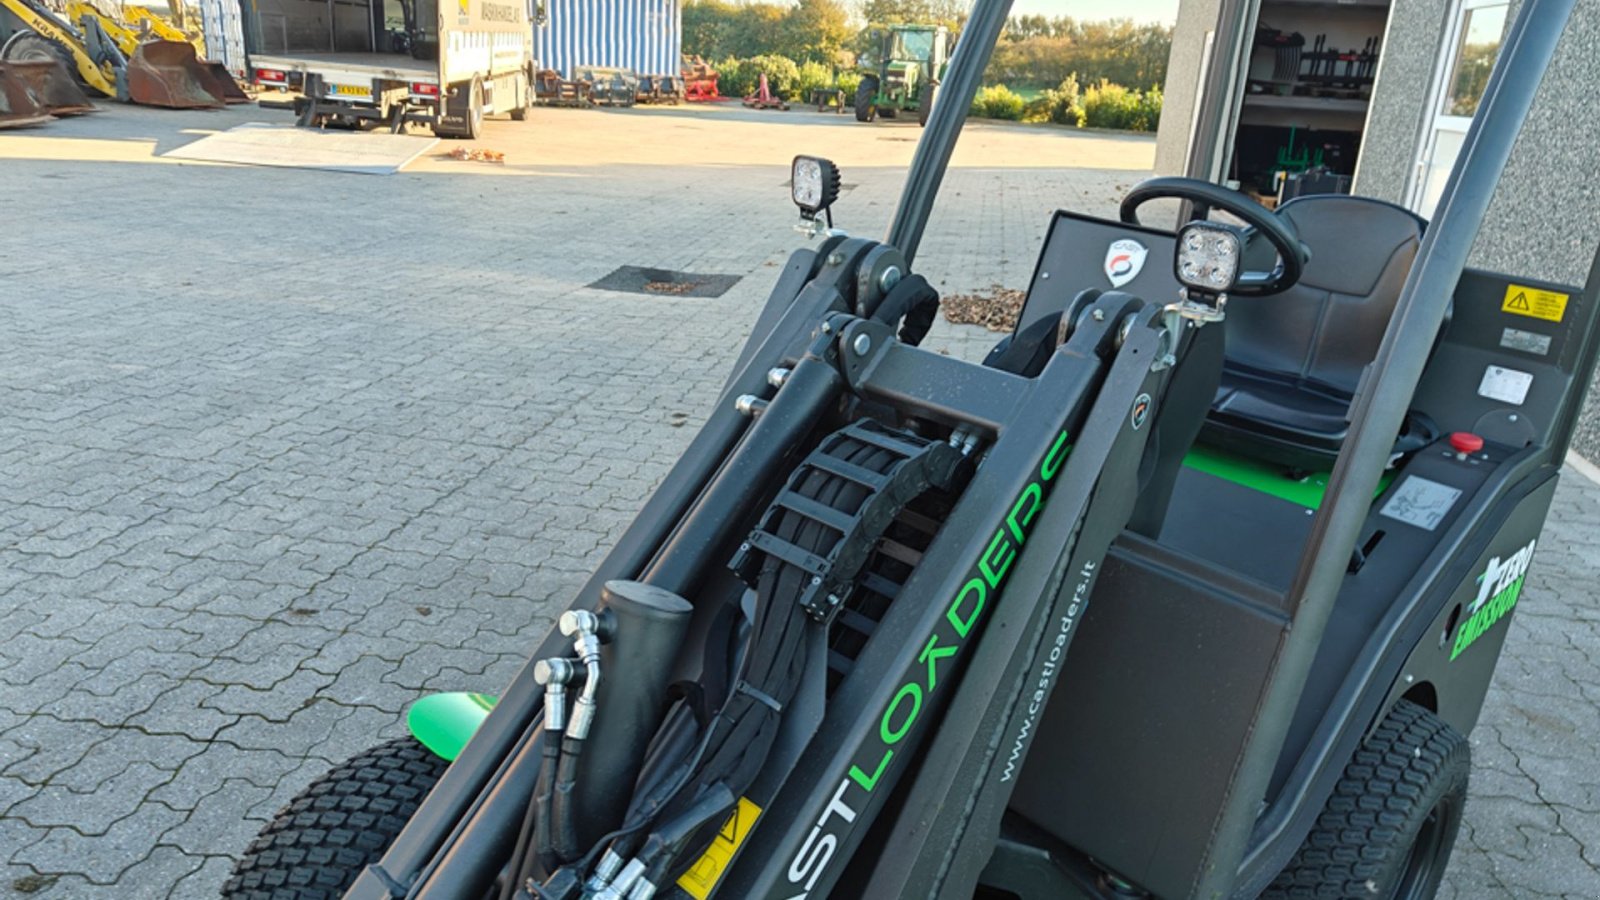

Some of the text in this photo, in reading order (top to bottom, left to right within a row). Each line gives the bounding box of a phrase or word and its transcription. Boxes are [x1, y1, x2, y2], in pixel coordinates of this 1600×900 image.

[1491, 539, 1536, 598] ZERO
[1450, 572, 1525, 662] EMISSION
[1000, 560, 1096, 782] www.castloaders.it
